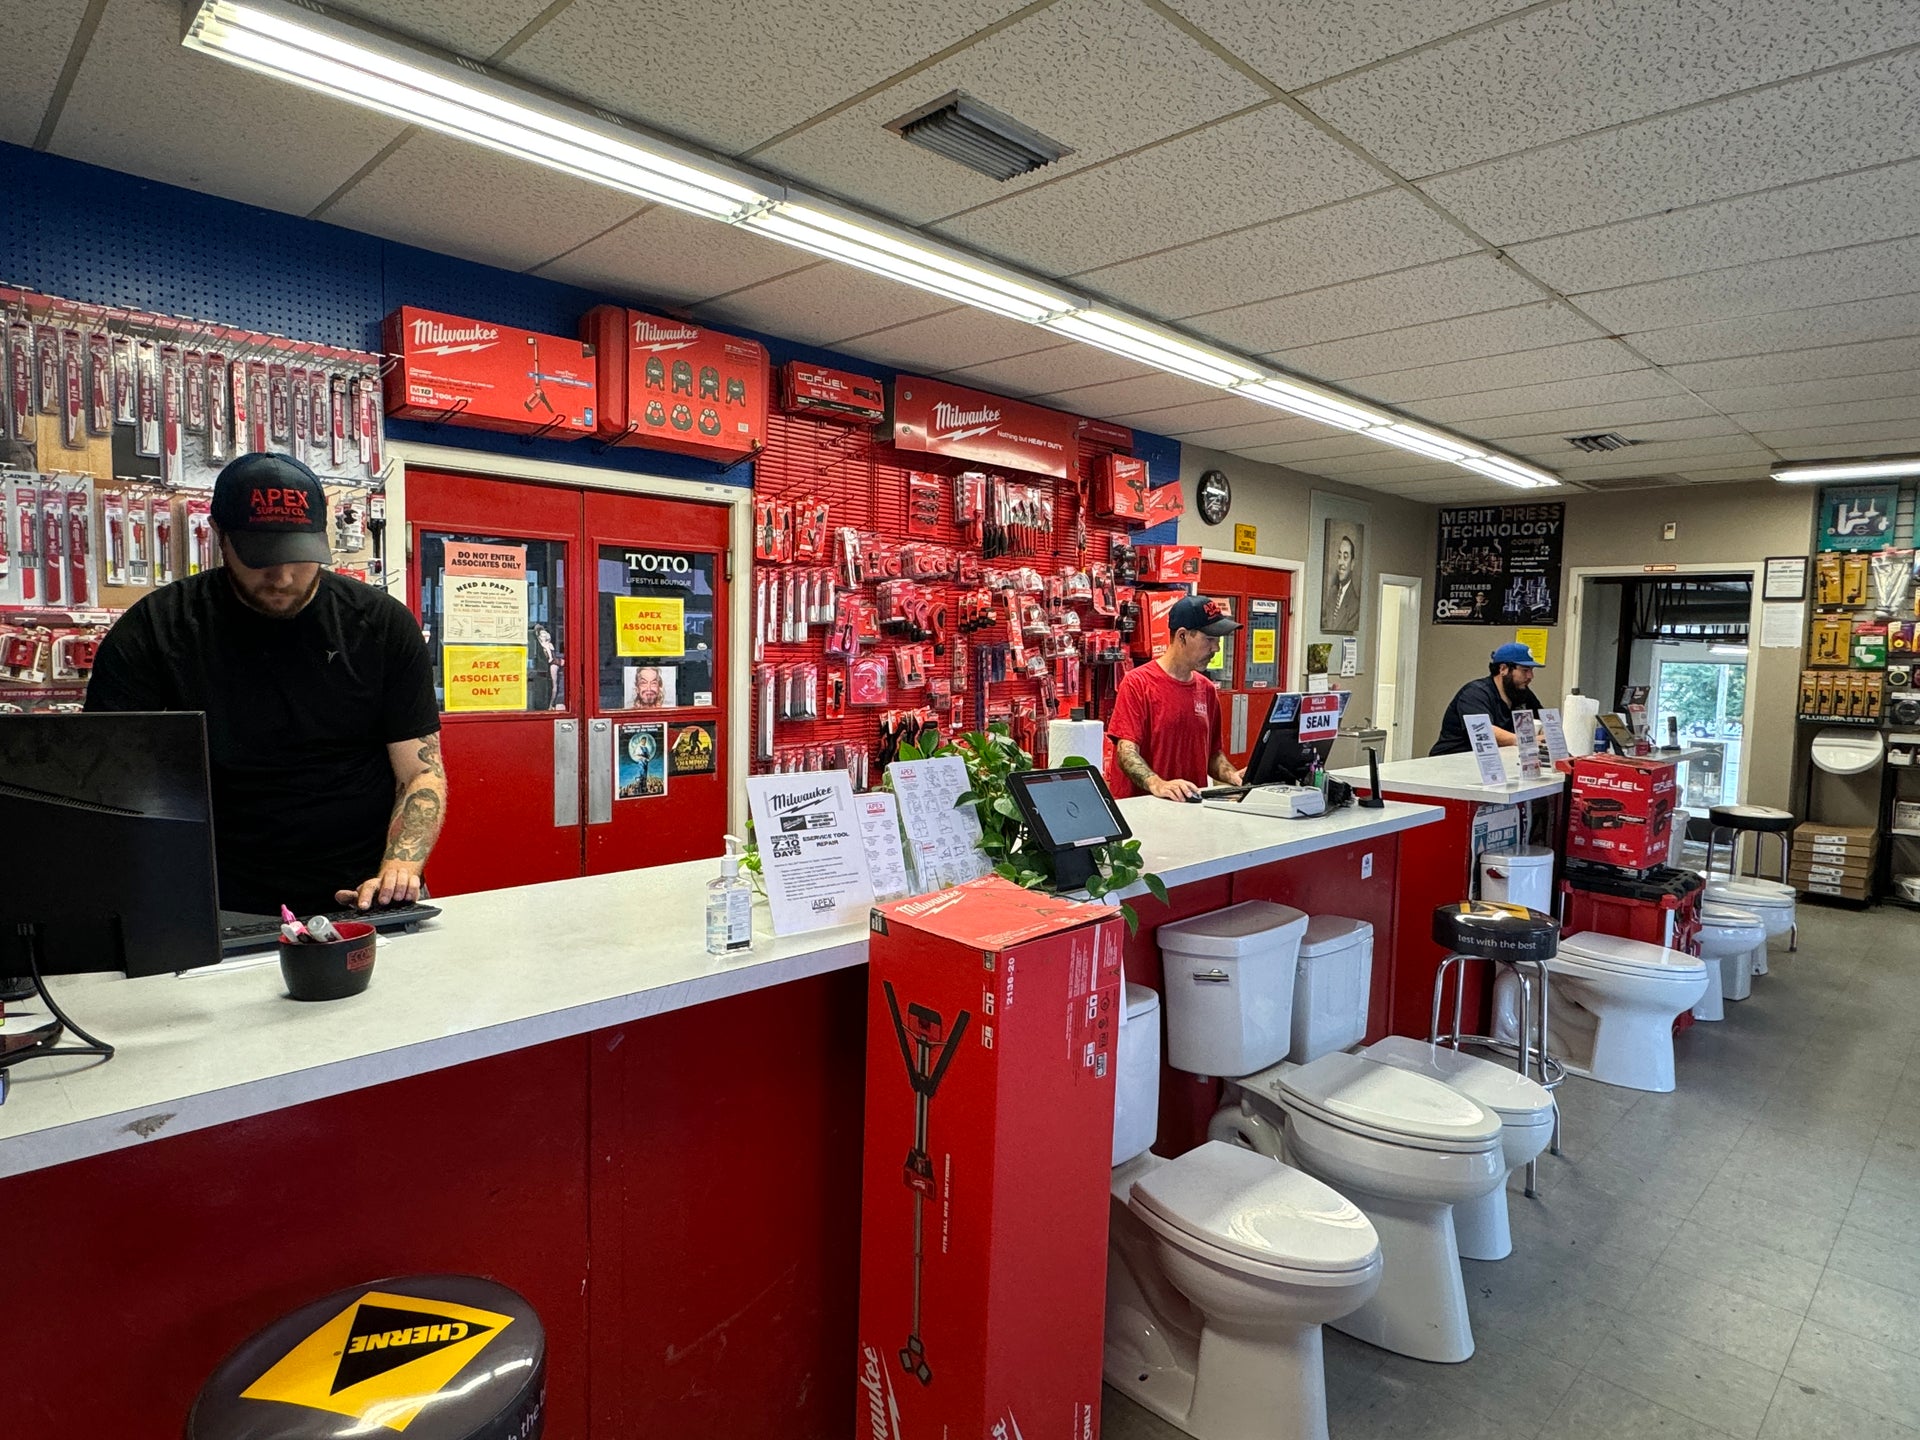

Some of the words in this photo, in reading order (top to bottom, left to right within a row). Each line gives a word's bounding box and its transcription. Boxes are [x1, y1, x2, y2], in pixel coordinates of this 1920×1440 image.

[407, 318, 499, 345] Milwaukee
[631, 320, 698, 342] Milwaukee
[813, 376, 848, 390] FUEL
[412, 387, 431, 396] M18
[932, 401, 1001, 431] Milwaukee
[997, 430, 1018, 442] Nothing
[1018, 435, 1028, 443] but
[1027, 437, 1047, 447] HEAVY
[250, 488, 309, 509] APEX
[256, 506, 291, 516] SUPPLY
[1441, 509, 1495, 525] MERIT
[1501, 505, 1561, 522] PRESS
[1441, 521, 1560, 539] TECHNOLOGY
[458, 551, 470, 559] DO
[472, 552, 488, 560] NOT
[490, 553, 516, 562] ENTER
[625, 553, 689, 574] TOTO
[451, 559, 500, 568] ASSOCIATES
[501, 562, 521, 570] ONLY
[456, 581, 478, 592] NEED
[489, 582, 514, 595] PART?
[626, 577, 659, 585] LIFESTYLE
[660, 579, 691, 587] BOUTIQUE
[1450, 583, 1492, 591] STAINLESS
[1450, 590, 1473, 598] STEEL
[638, 611, 662, 619] APEX
[1436, 598, 1459, 618] 85
[623, 623, 678, 631] ASSOCIATES
[638, 635, 662, 643] ONLY
[472, 661, 500, 669] APEX
[452, 674, 519, 682] ASSOCIATES
[471, 687, 501, 696] ONLY
[1306, 714, 1330, 729] SEAN
[1799, 713, 1875, 723] FLUIDMASTER
[1597, 778, 1645, 792] FUEL
[768, 786, 833, 811] Milwaukee
[772, 840, 800, 849] 7-10
[774, 849, 802, 858] DAYS
[812, 897, 836, 908] APEX
[894, 890, 962, 917] Milwaukee
[1458, 934, 1475, 944] test
[1476, 938, 1497, 948] with
[1500, 940, 1516, 949] the
[1517, 941, 1537, 950] best
[348, 1321, 469, 1354] CHERNE
[521, 1403, 540, 1438] the
